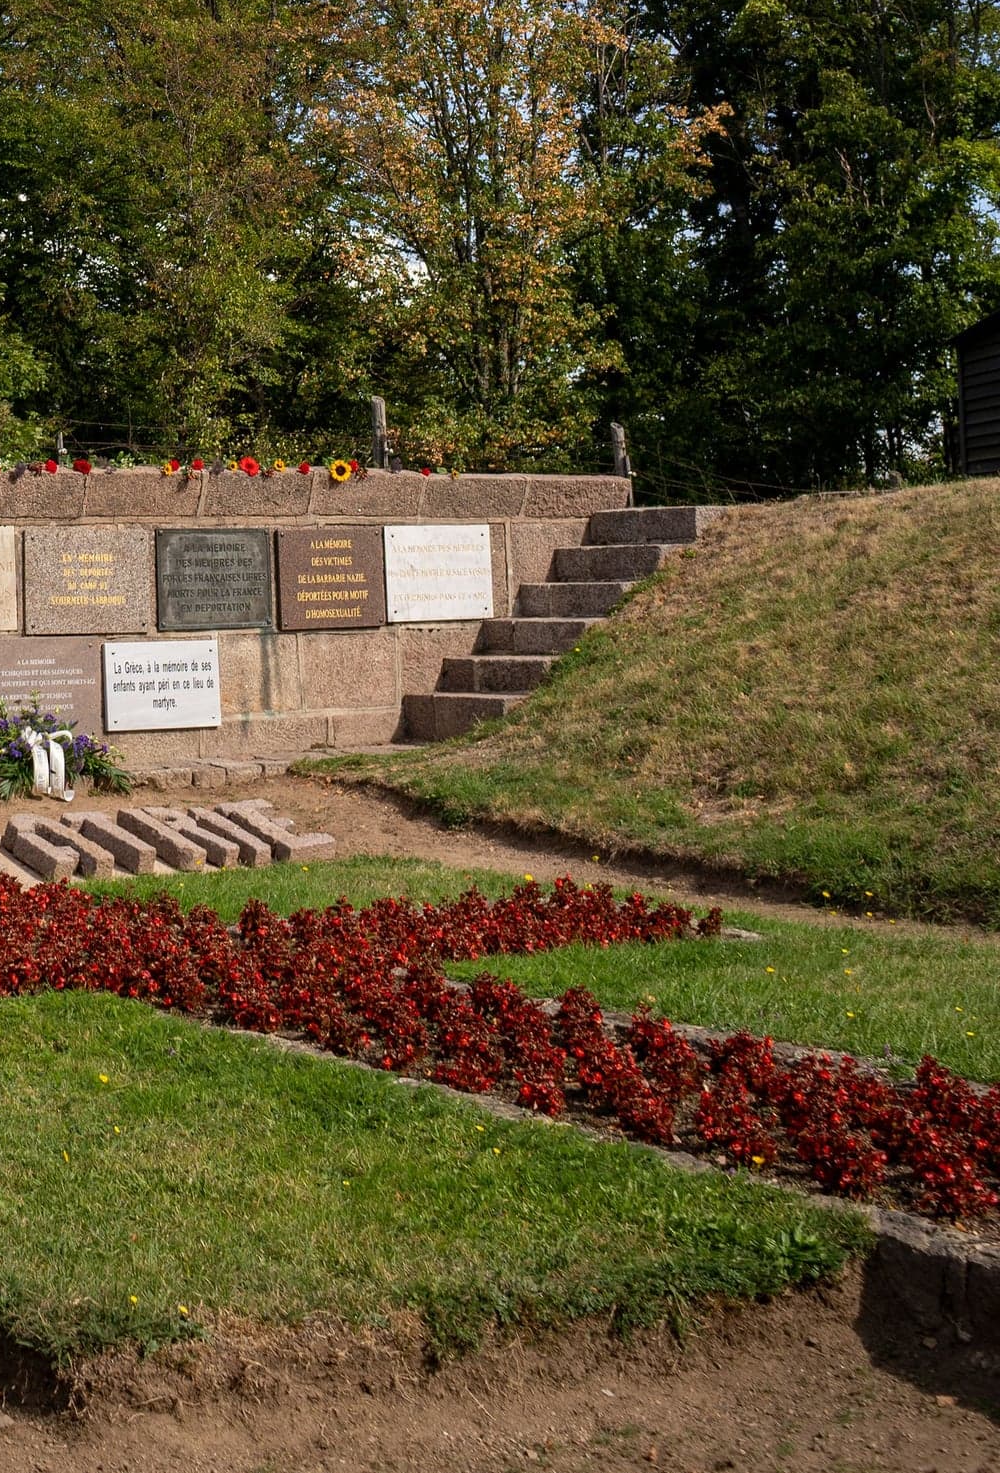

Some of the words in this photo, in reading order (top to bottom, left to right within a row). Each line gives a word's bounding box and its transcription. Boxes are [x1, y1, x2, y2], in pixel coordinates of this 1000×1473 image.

[315, 540, 323, 548] LA
[324, 538, 352, 548] MÉMOIRE
[175, 559, 192, 568] DES
[238, 558, 253, 567] DES
[311, 557, 325, 566] DES
[325, 556, 352, 566] VICTIMES
[162, 574, 193, 583] FORCES
[242, 572, 268, 582] LIBRES
[298, 575, 306, 584] DE
[308, 575, 316, 583] LA
[317, 574, 346, 583] BARBARIE
[168, 588, 195, 598] MORTS
[197, 588, 218, 598] POUR
[221, 588, 230, 597] LA
[232, 587, 263, 597] FRANCE
[297, 589, 332, 601] DÉPORTÉES
[333, 591, 349, 600] POUR
[350, 590, 369, 600] MOTIF
[114, 662, 122, 674] La
[125, 661, 145, 675] Grèce,
[147, 661, 152, 673] à
[154, 661, 160, 672] la
[163, 660, 189, 672] mémoire
[191, 660, 199, 671] de
[202, 662, 212, 671] ses
[113, 680, 136, 692] enfants
[139, 680, 156, 694] ayant
[158, 678, 170, 692] péri
[173, 681, 181, 690] en
[183, 680, 190, 689] ce
[193, 677, 204, 689] lieu
[207, 677, 214, 689] de
[153, 697, 178, 711] martyre.
